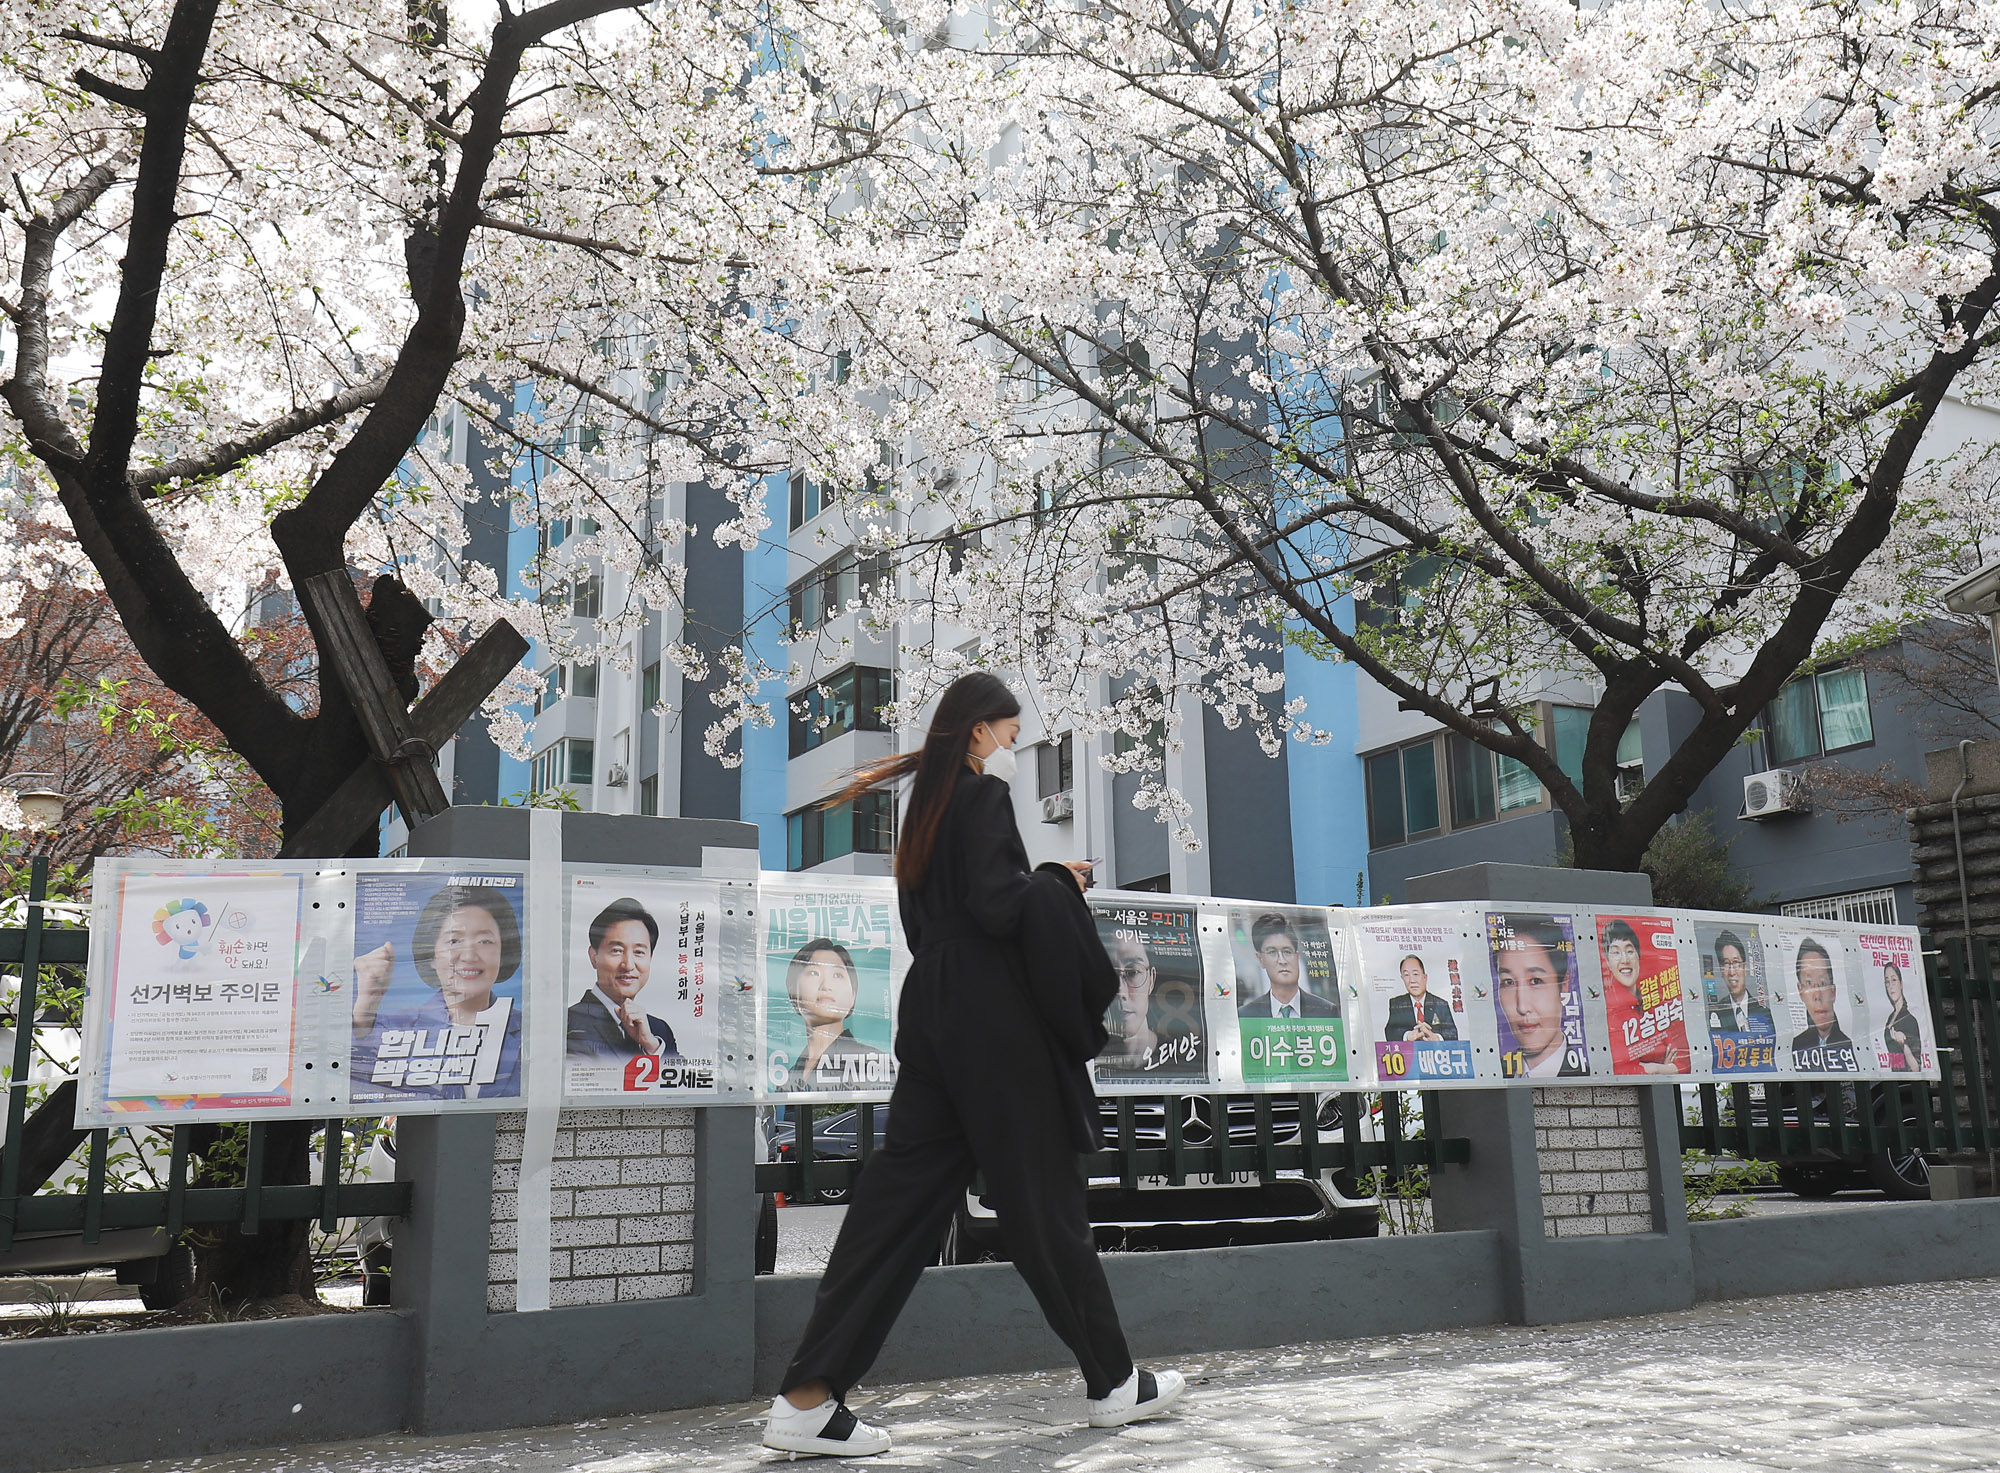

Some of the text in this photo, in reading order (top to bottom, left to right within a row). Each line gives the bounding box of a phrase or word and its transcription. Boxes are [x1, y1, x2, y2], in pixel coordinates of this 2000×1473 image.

[447, 876, 480, 887] 서울시
[766, 904, 892, 951] 서울기본소득
[1113, 909, 1189, 928] 서울은 무지개
[1487, 915, 1506, 926] 여자
[1489, 927, 1516, 939] 혼자도
[219, 939, 268, 954] 훼손하면
[694, 911, 706, 958] 서울부터
[1115, 928, 1151, 944] 이기는
[1556, 941, 1573, 952] 서울
[225, 957, 268, 969] 안 돼요!
[677, 901, 690, 1001] 첫날부터 능숙하게
[1872, 951, 1889, 967] 있는
[130, 982, 281, 1004] 선거벽보 주의문
[1639, 964, 1679, 996] 강남 해체!
[1641, 979, 1681, 1011] 평등 서울!
[1560, 990, 1588, 1073] 김진아
[1622, 1017, 1640, 1047] 12
[1640, 998, 1684, 1039] 송명숙
[377, 1029, 484, 1059] 합니다
[474, 996, 515, 1086] 1
[1142, 1032, 1201, 1071] 오태양
[1250, 1034, 1337, 1067] 이수봉 9
[1713, 1037, 1774, 1069] 13 정동희
[370, 1057, 478, 1087] 박영선
[634, 1057, 654, 1088] 2
[660, 1068, 714, 1089] 오세훈
[768, 1049, 891, 1086] 6 신지혜
[1382, 1050, 1468, 1076] 10 배영규
[1502, 1051, 1524, 1075] 11
[1792, 1047, 1858, 1072] 14 이도엽
[1920, 1053, 1932, 1069] 15
